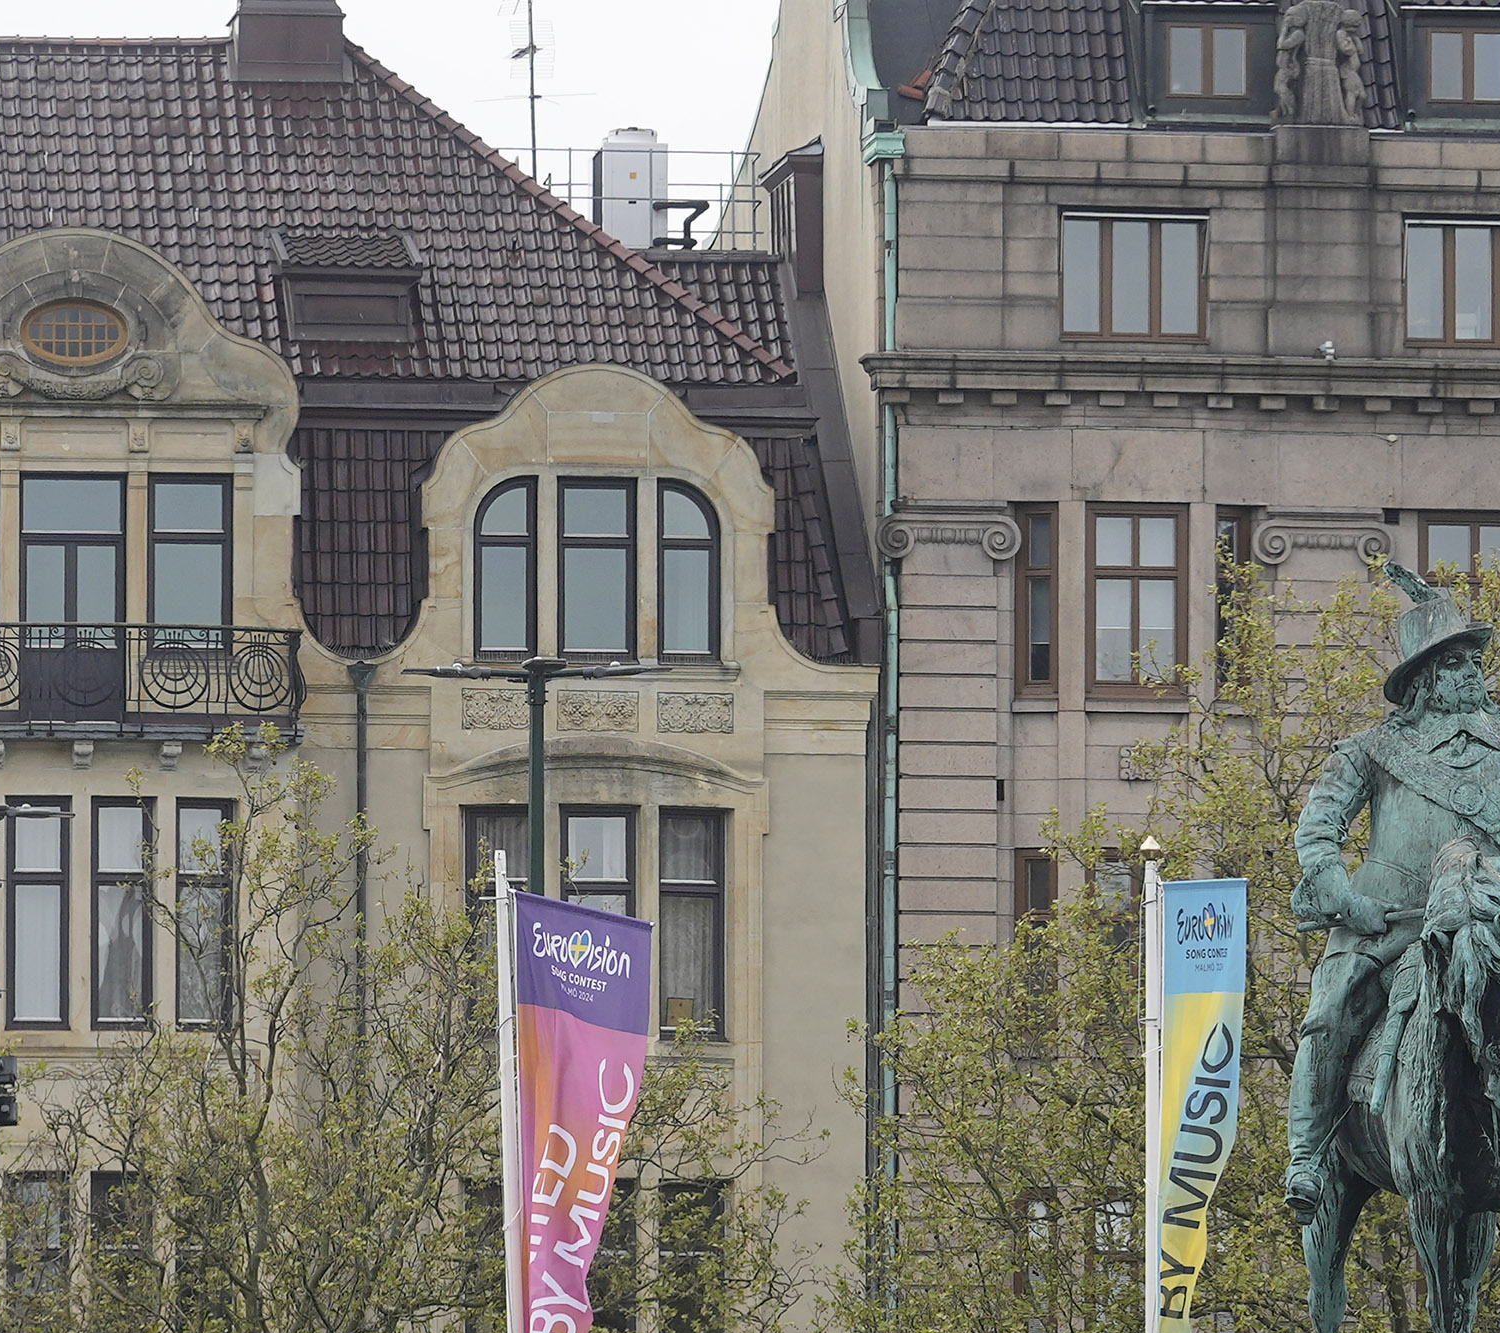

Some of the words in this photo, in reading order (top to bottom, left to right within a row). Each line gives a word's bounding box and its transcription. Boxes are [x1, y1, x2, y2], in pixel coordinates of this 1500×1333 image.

[567, 972, 607, 992] CONTEST
[1185, 948, 1206, 960] SONG
[1162, 1022, 1235, 1229] MUSIC
[553, 1057, 636, 1269] MUSIC
[1160, 1249, 1195, 1320] BY
